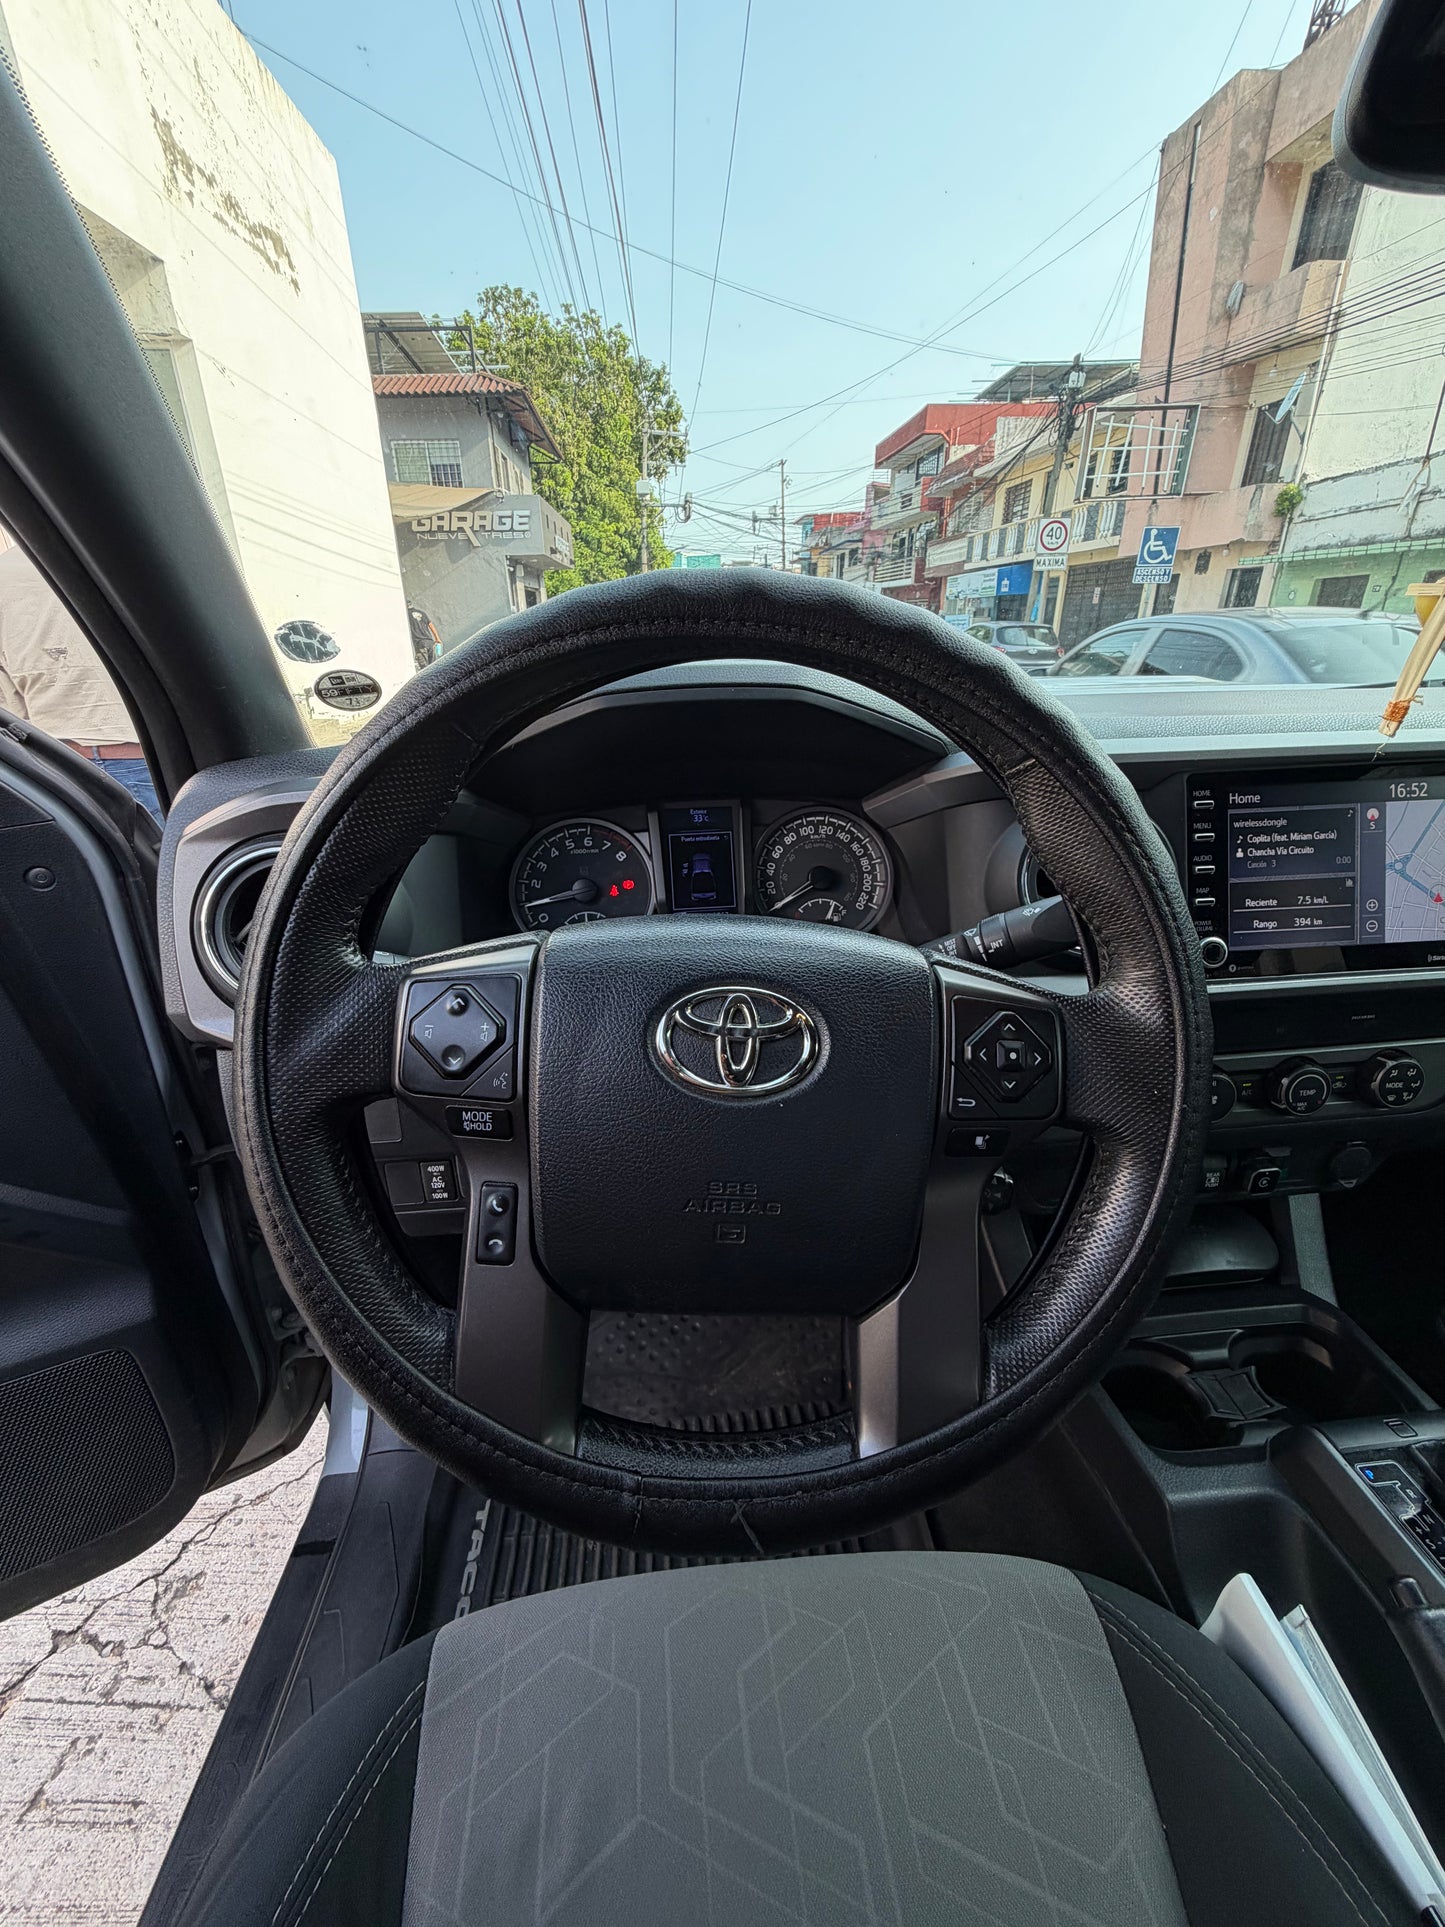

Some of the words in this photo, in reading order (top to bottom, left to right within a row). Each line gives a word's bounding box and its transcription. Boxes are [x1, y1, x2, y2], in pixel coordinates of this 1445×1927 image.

[411, 510, 531, 546] GARAGE
[1046, 526, 1063, 540] 40
[416, 532, 468, 540] NUEVE
[1036, 558, 1065, 567] MAXIMA
[1135, 575, 1168, 583] DESCENSO
[1389, 783, 1428, 798] 16:52
[1229, 793, 1261, 805] Home
[1233, 817, 1287, 829] wirelessdongle
[799, 825, 815, 836] 100
[818, 825, 833, 835] 120
[583, 837, 593, 847] 6
[783, 832, 797, 846] 80
[835, 830, 851, 843] 140
[1247, 834, 1271, 845] Coplita
[1271, 833, 1289, 843] (feat.
[1290, 832, 1312, 841] Miriam
[1313, 830, 1338, 841] García)
[564, 838, 576, 850] 5
[601, 840, 612, 851] 7
[850, 841, 864, 857] 160
[550, 847, 560, 858] 4
[615, 851, 627, 861] 8
[771, 845, 784, 860] 60
[1247, 847, 1276, 857] Chancha
[1276, 846, 1288, 855] Vía
[1288, 845, 1315, 855] Circuito
[860, 857, 871, 872] 180
[1335, 856, 1352, 864] 0:00
[536, 861, 548, 873] 3
[766, 863, 776, 877] 40
[531, 879, 542, 889] 2
[767, 882, 776, 895] 20
[862, 873, 872, 892] 200
[855, 893, 869, 910] 220
[1245, 899, 1278, 907] Reciente
[1297, 896, 1312, 905] 7.5
[1313, 896, 1329, 904] km/L
[538, 913, 549, 923] 0
[1253, 920, 1278, 930] Rango
[1294, 918, 1312, 927] 394
[1313, 918, 1324, 926] km
[989, 939, 1003, 949] INT
[462, 1111, 493, 1122] MODE
[470, 1122, 493, 1131] HOLD
[709, 1182, 757, 1194] SRS
[683, 1200, 781, 1215] AIRBAG
[1365, 1470, 1374, 1480] P
[1425, 1538, 1436, 1550] S
